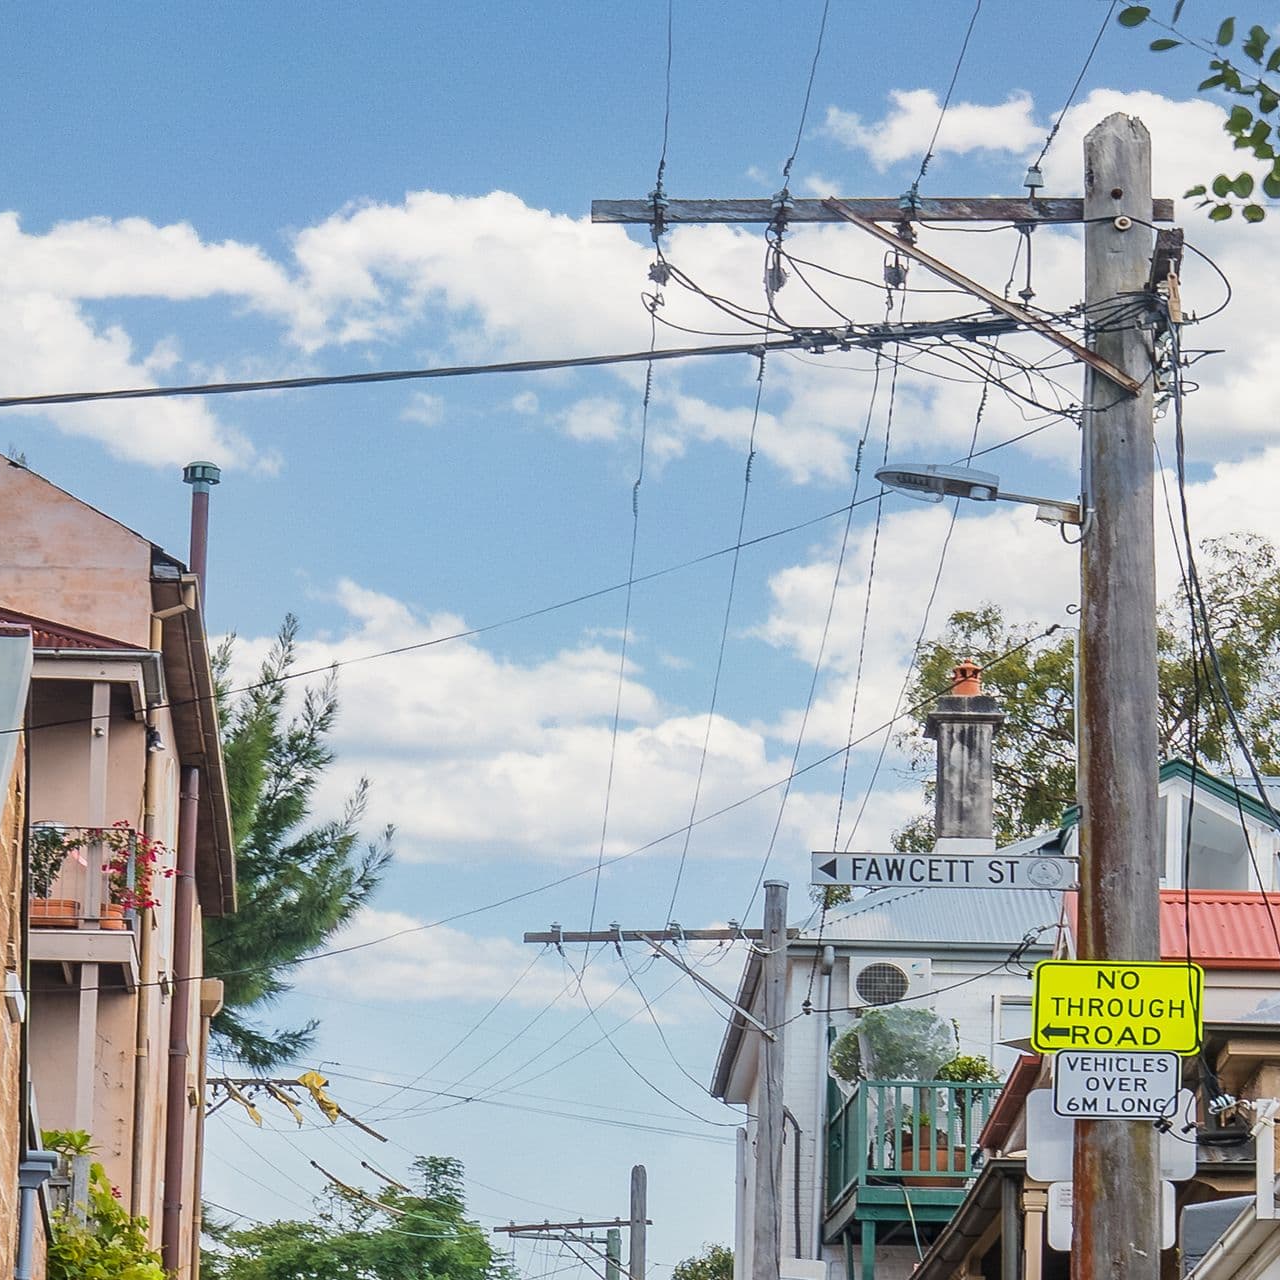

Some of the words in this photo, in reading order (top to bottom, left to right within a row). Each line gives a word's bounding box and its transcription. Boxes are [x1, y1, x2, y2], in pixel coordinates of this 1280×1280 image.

[851, 858, 974, 884] FAWCETT
[987, 860, 1020, 884] ST
[1096, 970, 1140, 990] NO
[1050, 997, 1185, 1019] THROUGH
[1071, 1025, 1161, 1046] ROAD
[1066, 1056, 1169, 1073] VEHICLES
[1086, 1077, 1148, 1092] OVER
[1066, 1097, 1098, 1112] 6M
[1107, 1097, 1167, 1113] LONG
